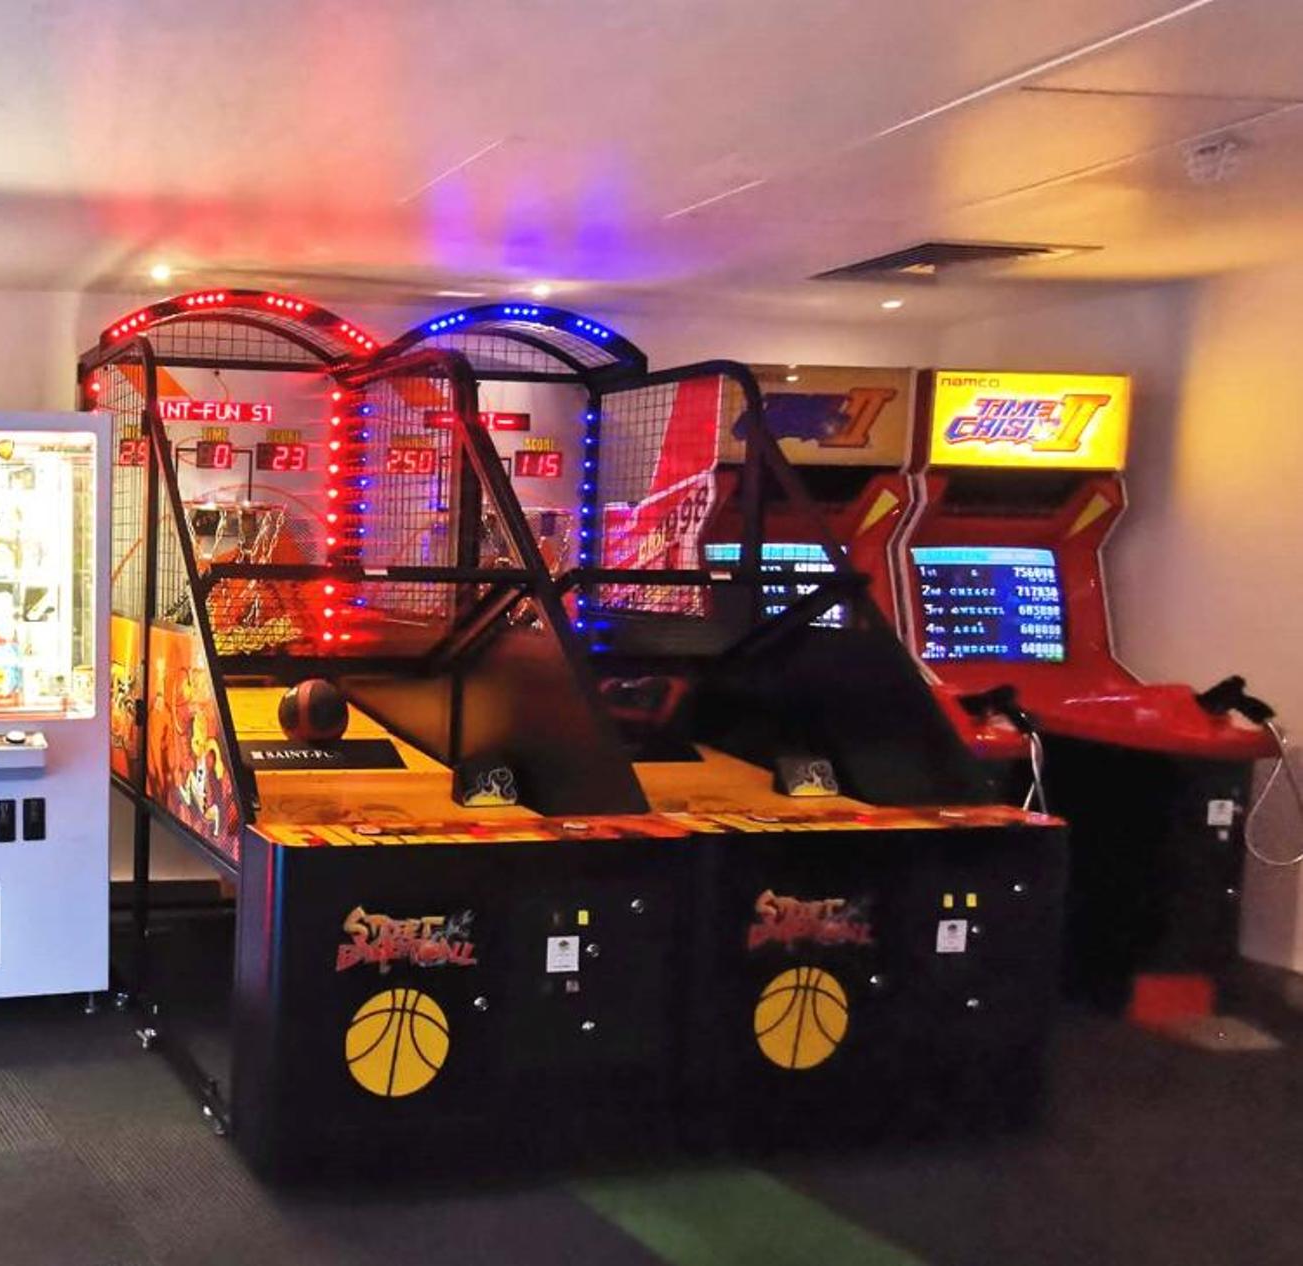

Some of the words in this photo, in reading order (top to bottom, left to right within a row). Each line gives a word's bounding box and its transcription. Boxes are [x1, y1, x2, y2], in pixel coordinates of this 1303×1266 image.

[941, 377, 1000, 388] namco
[975, 398, 1064, 417] TIME
[214, 444, 229, 467] 0
[272, 446, 305, 470] 23
[387, 450, 433, 473] 250
[521, 454, 560, 477] 115
